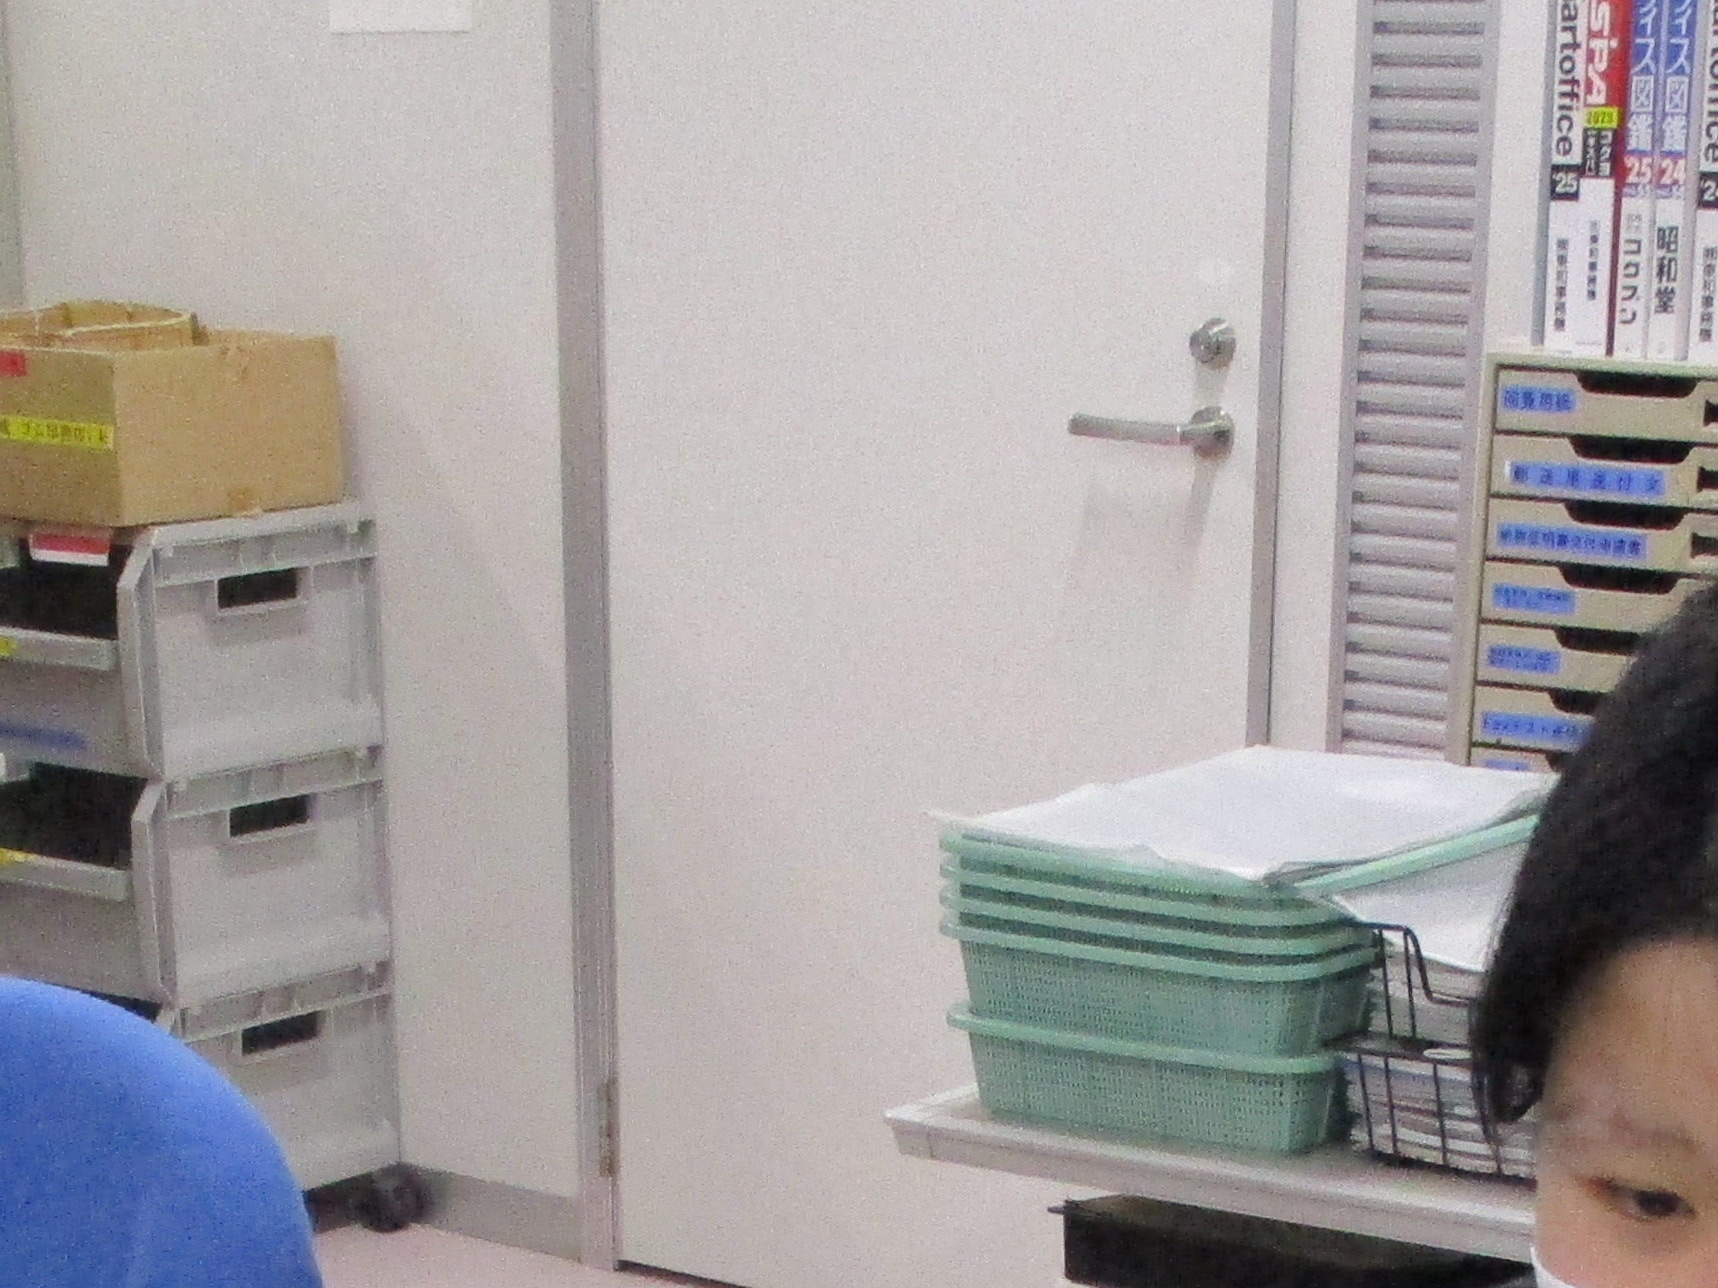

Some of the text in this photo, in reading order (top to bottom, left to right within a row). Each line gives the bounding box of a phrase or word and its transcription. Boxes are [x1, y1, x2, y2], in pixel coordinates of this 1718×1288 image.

[1555, 0, 1582, 157] artoffice
[1654, 226, 1679, 314] 昭和堂
